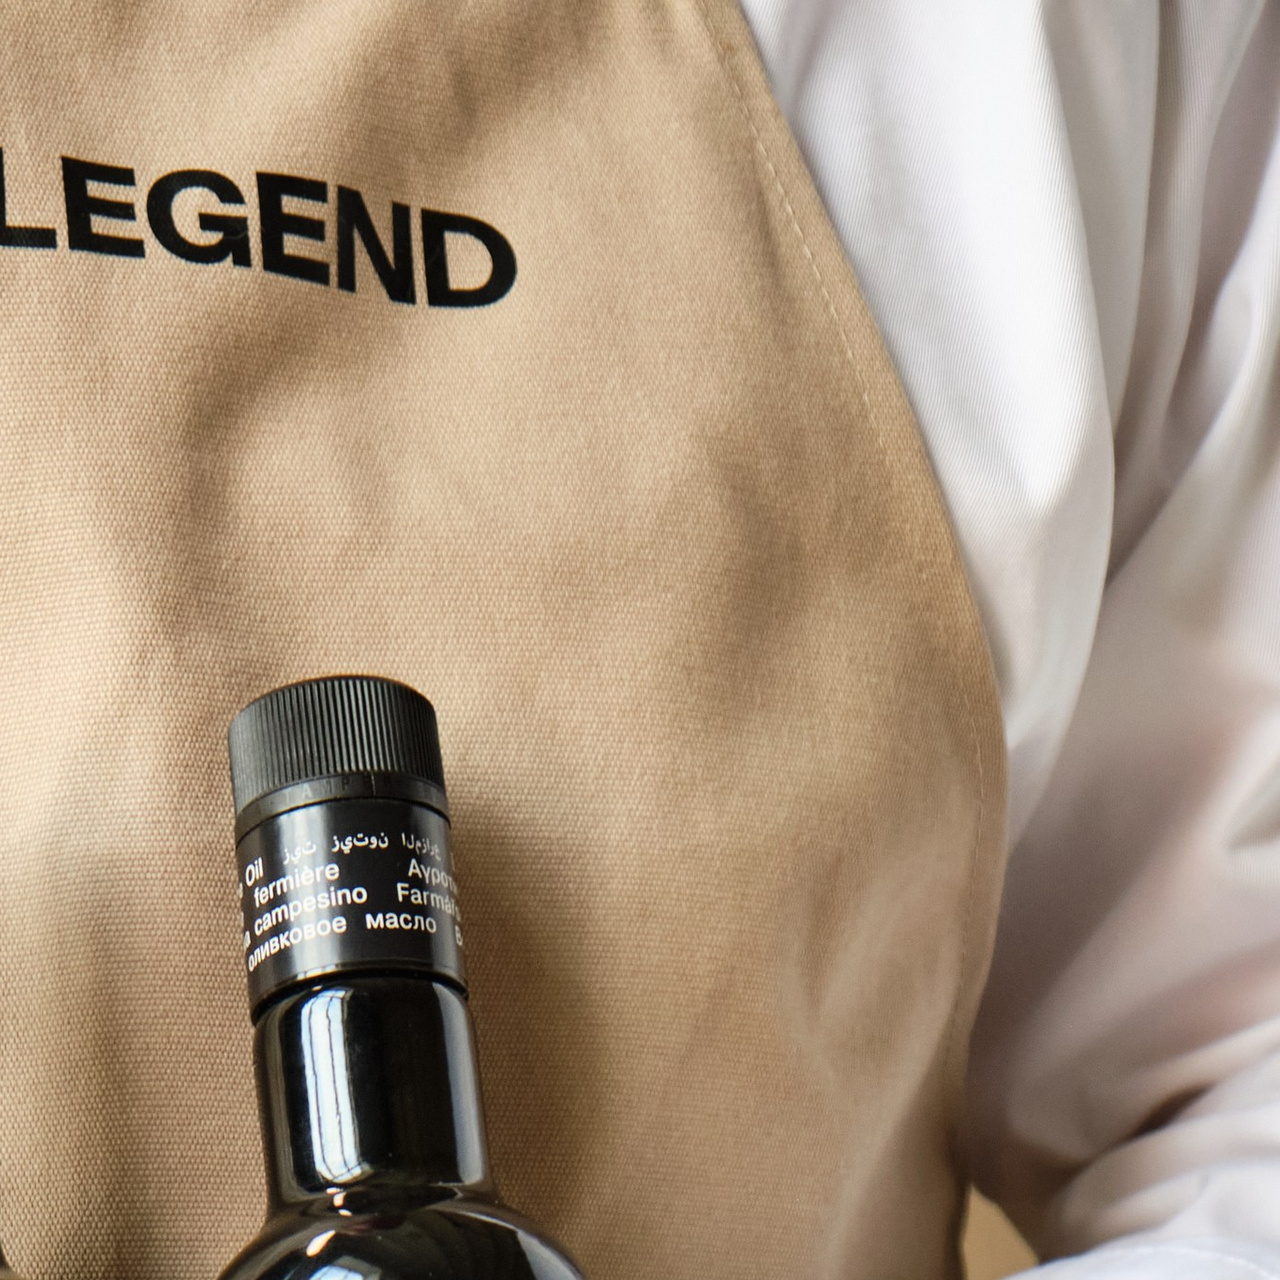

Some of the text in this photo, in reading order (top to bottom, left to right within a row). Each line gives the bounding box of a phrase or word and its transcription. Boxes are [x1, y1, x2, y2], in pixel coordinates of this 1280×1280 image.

[245, 857, 264, 887] Oil
[253, 862, 340, 908] fermière
[253, 886, 368, 937] campesino
[248, 915, 347, 972] оливковое
[365, 913, 437, 933] масло
